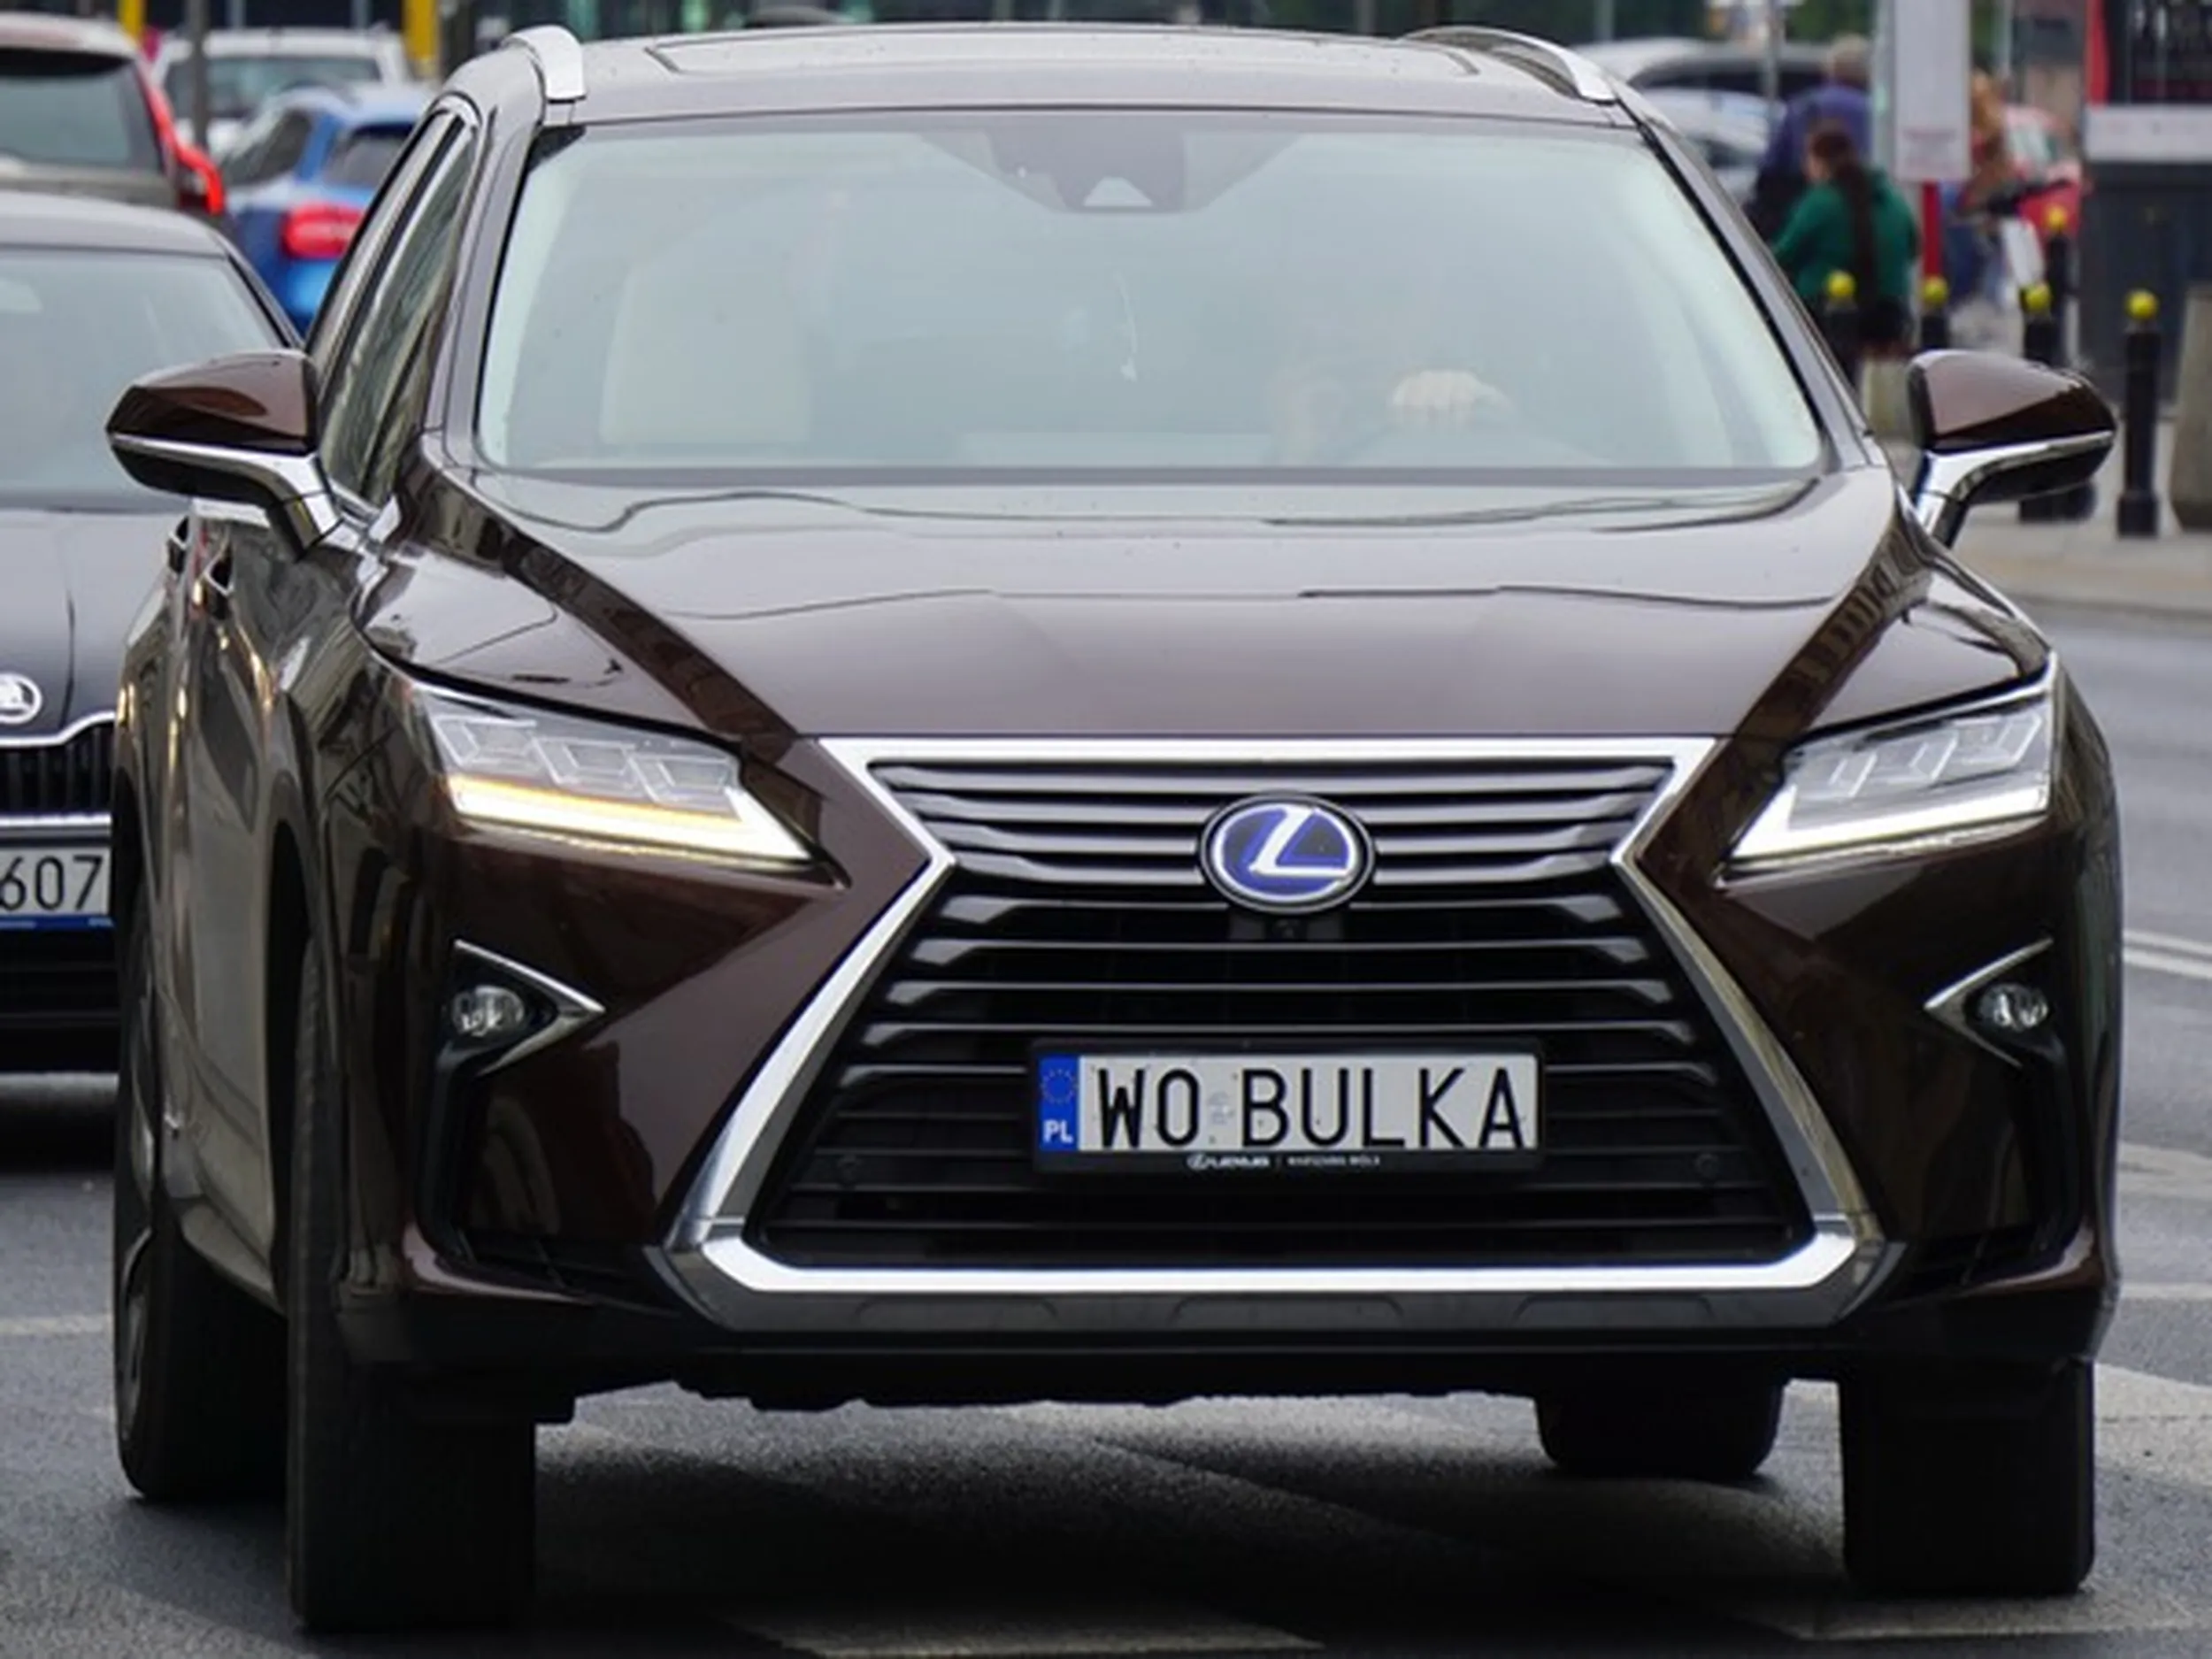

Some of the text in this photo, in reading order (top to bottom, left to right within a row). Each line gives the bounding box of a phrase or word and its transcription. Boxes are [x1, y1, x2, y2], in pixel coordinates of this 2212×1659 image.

[0, 854, 103, 910] 607
[1044, 1118, 1073, 1143] PL
[1098, 1068, 1525, 1148] WO BULKA
